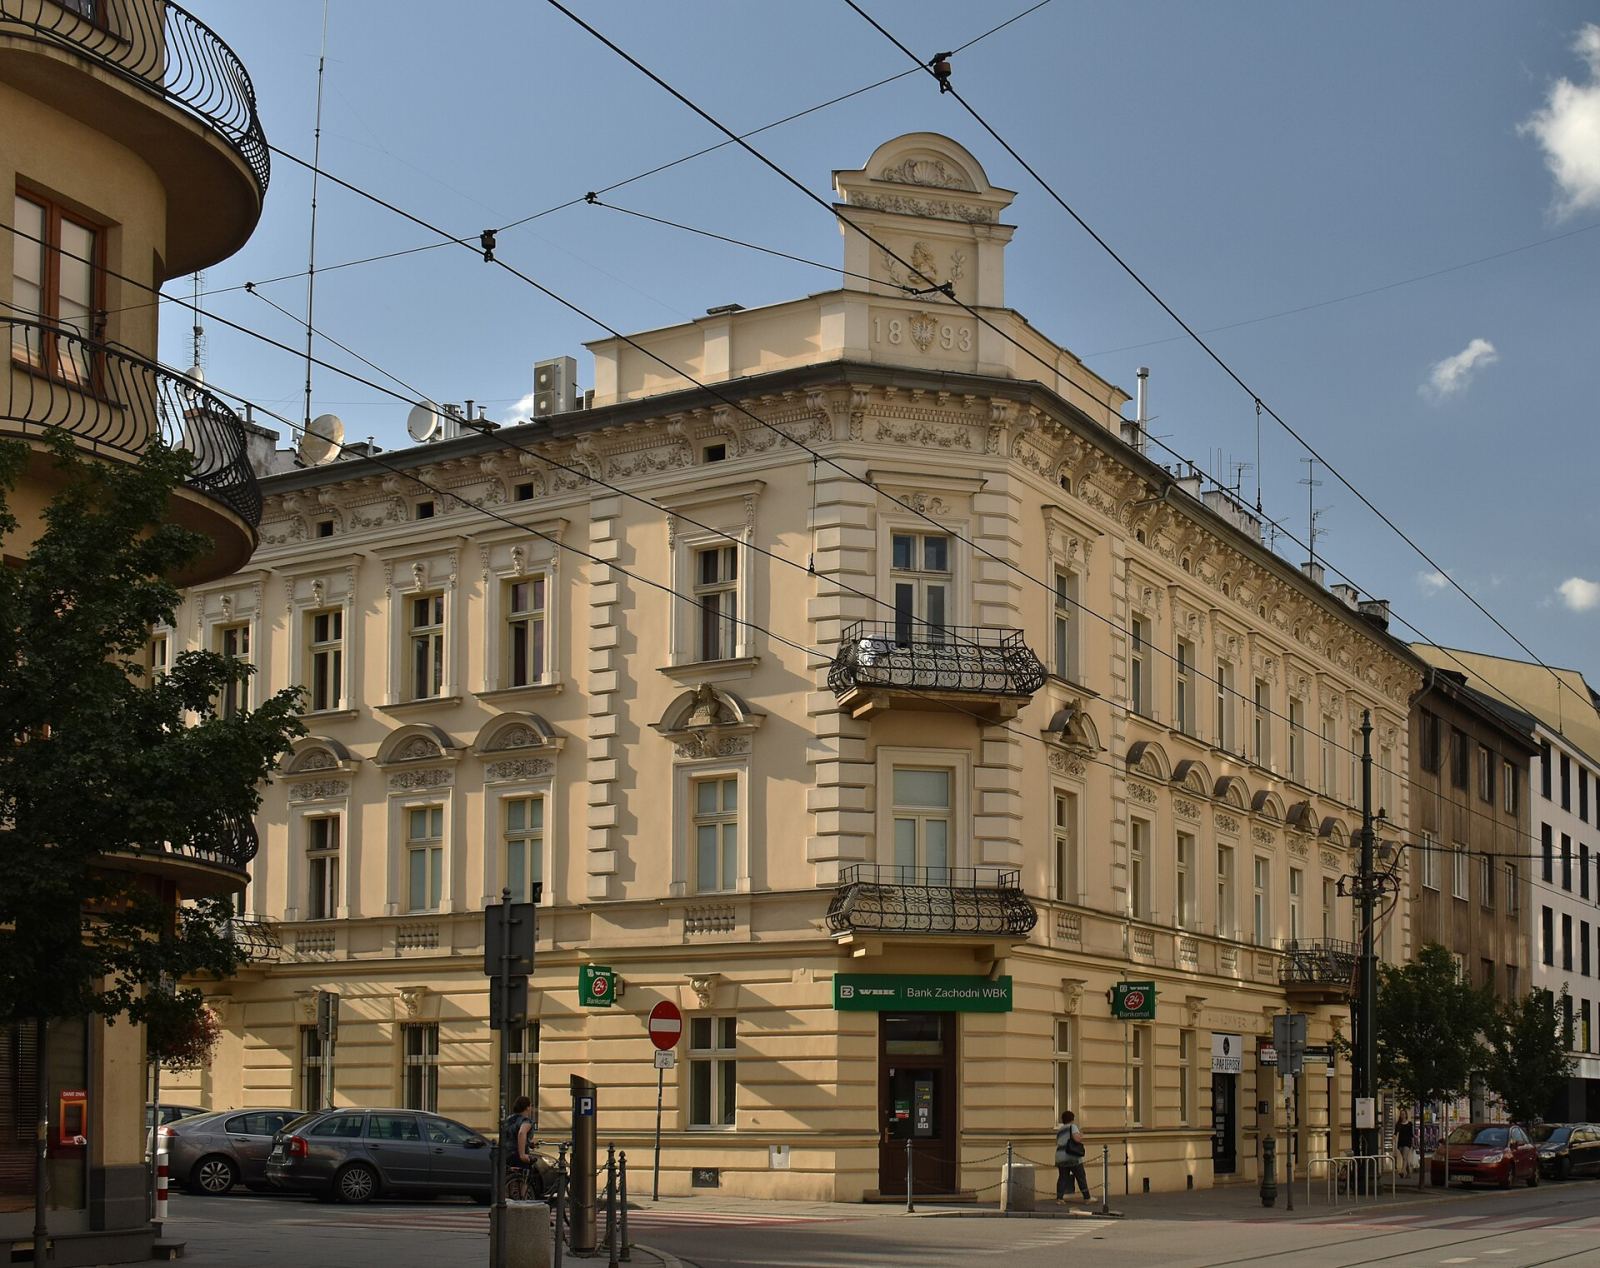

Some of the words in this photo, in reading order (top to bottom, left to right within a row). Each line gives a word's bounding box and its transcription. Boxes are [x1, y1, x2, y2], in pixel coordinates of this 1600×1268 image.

[907, 987, 932, 998] Bank
[935, 987, 980, 998] Zachodni
[982, 988, 1007, 998] WBK
[1128, 994, 1141, 1006] 24
[580, 1098, 592, 1115] P
